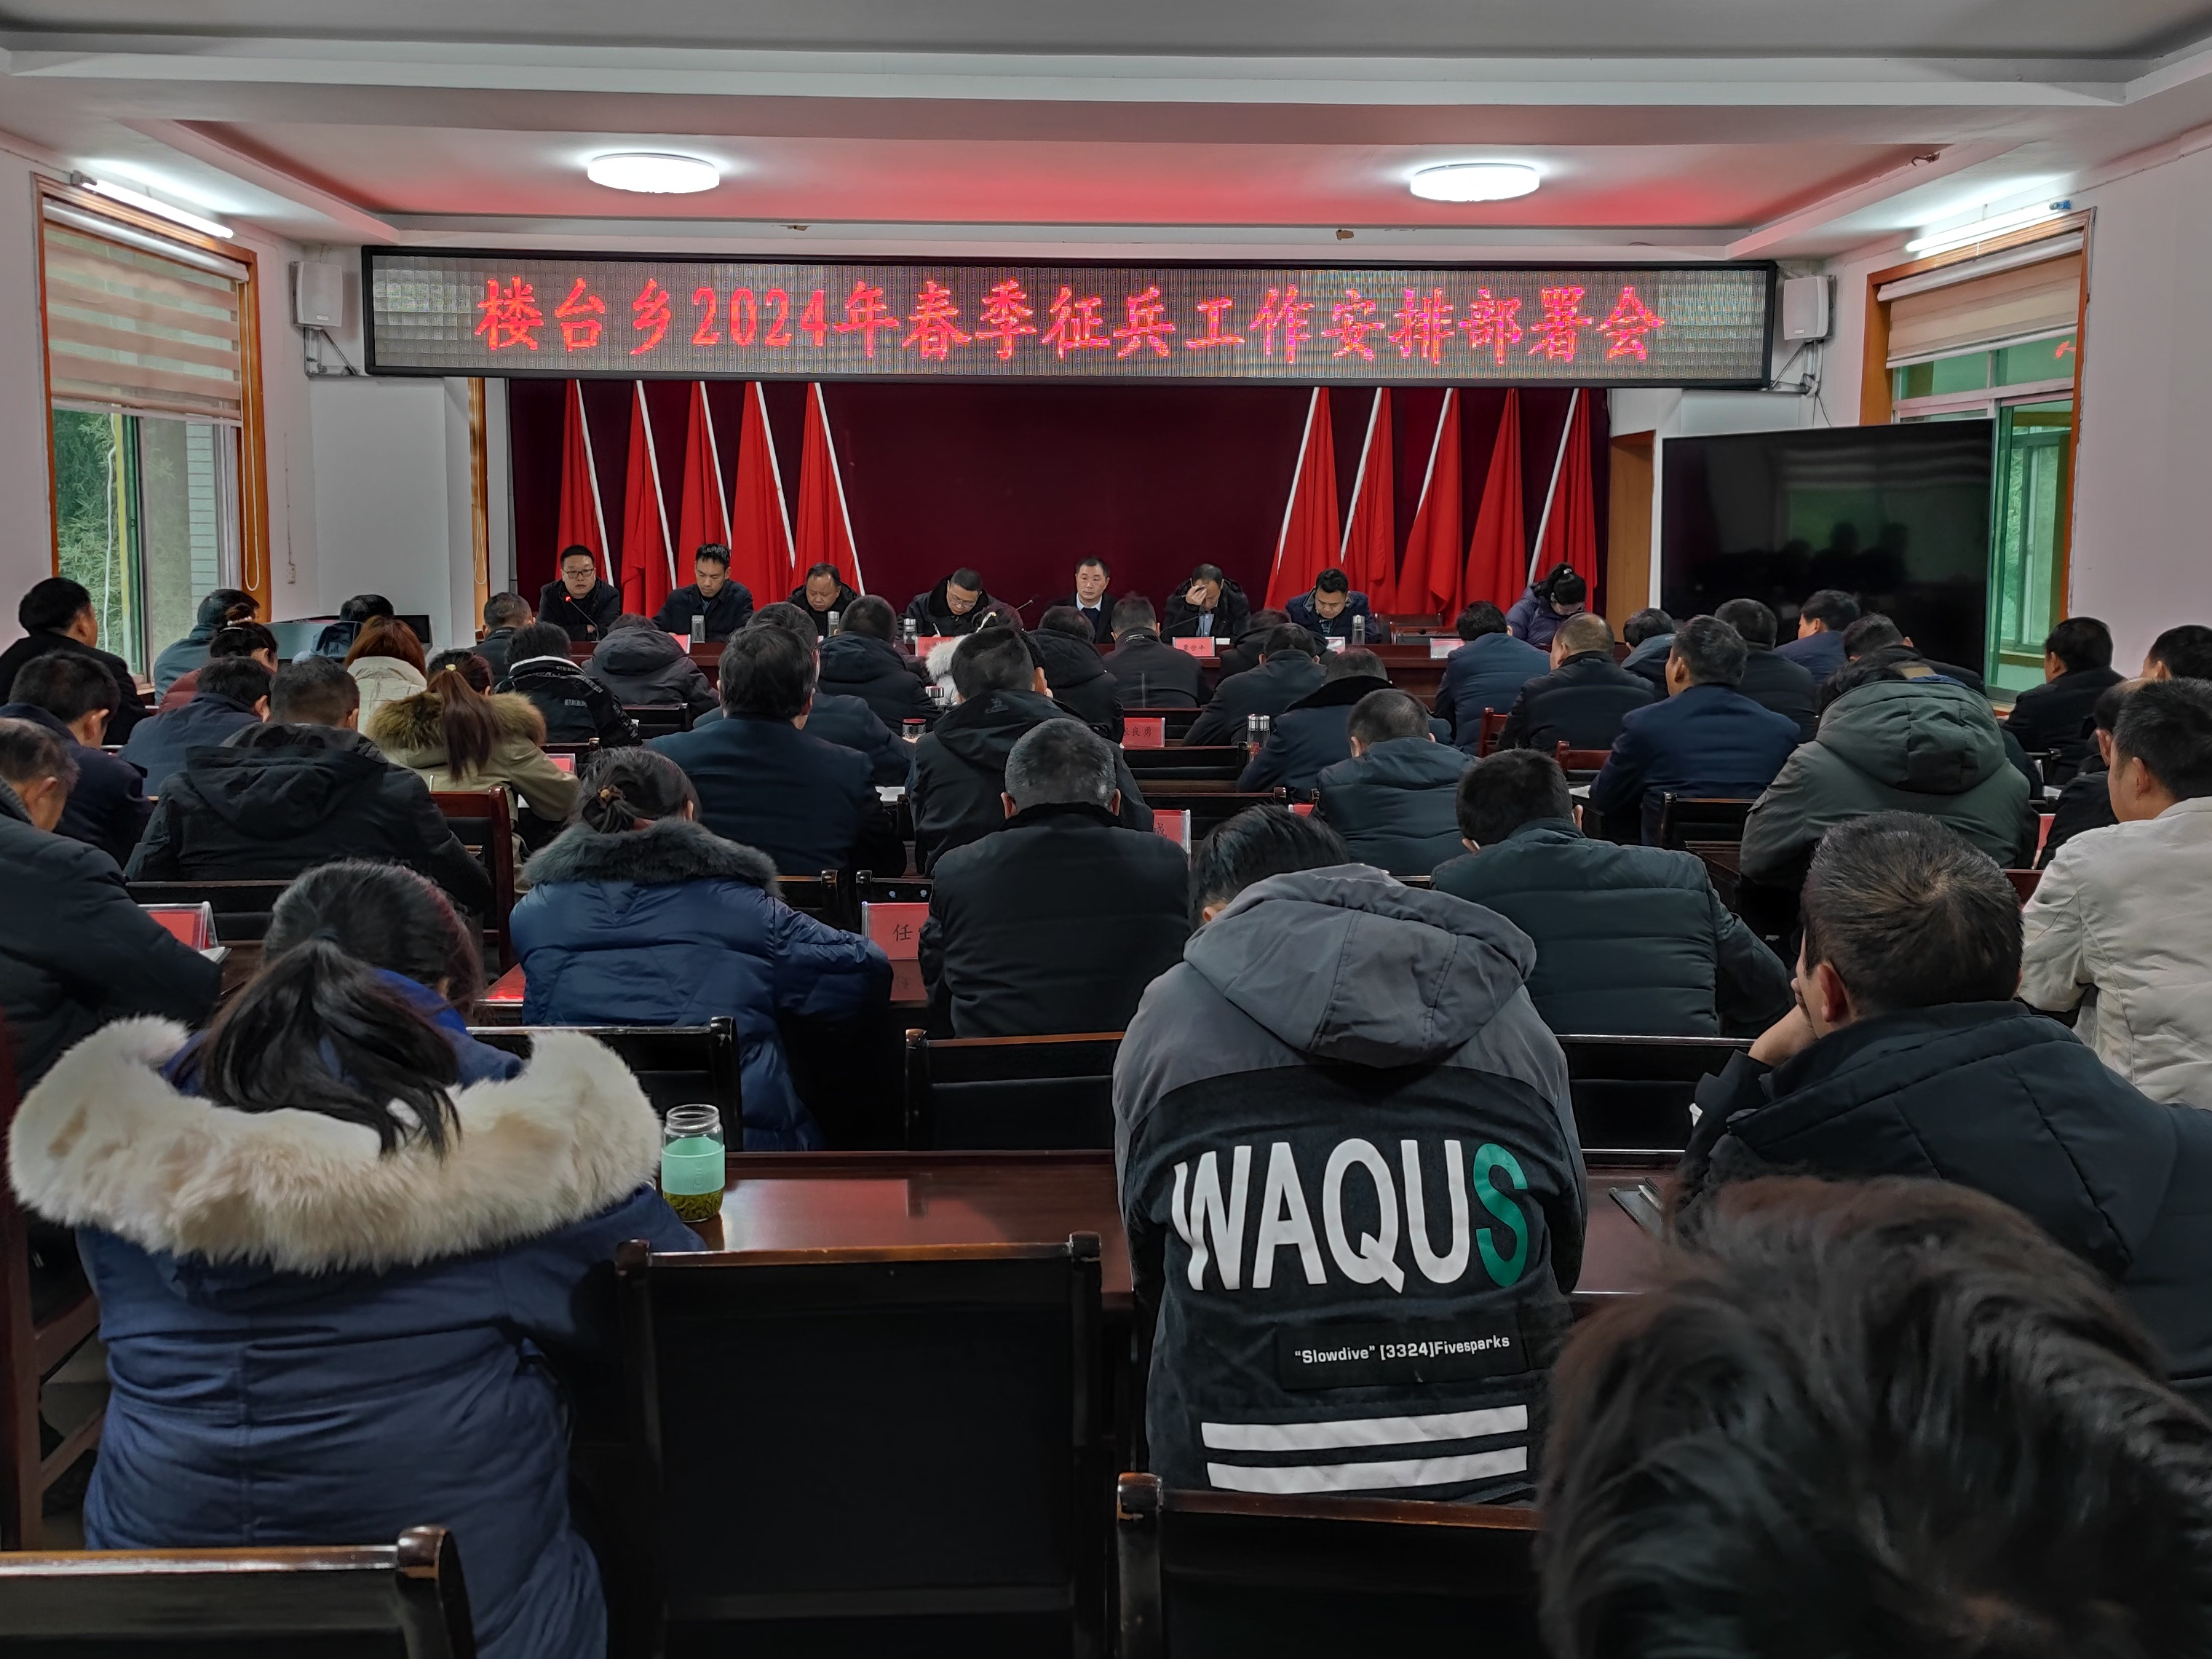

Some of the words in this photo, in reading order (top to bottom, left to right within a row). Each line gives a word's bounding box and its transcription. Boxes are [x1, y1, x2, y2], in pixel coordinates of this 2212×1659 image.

[475, 276, 1665, 364] 楼台乡2024年春季征兵工作安排部署会
[892, 923, 920, 942] 任
[1171, 1137, 1529, 1294] WAQUS
[1294, 1345, 1376, 1364] “Slowdive”
